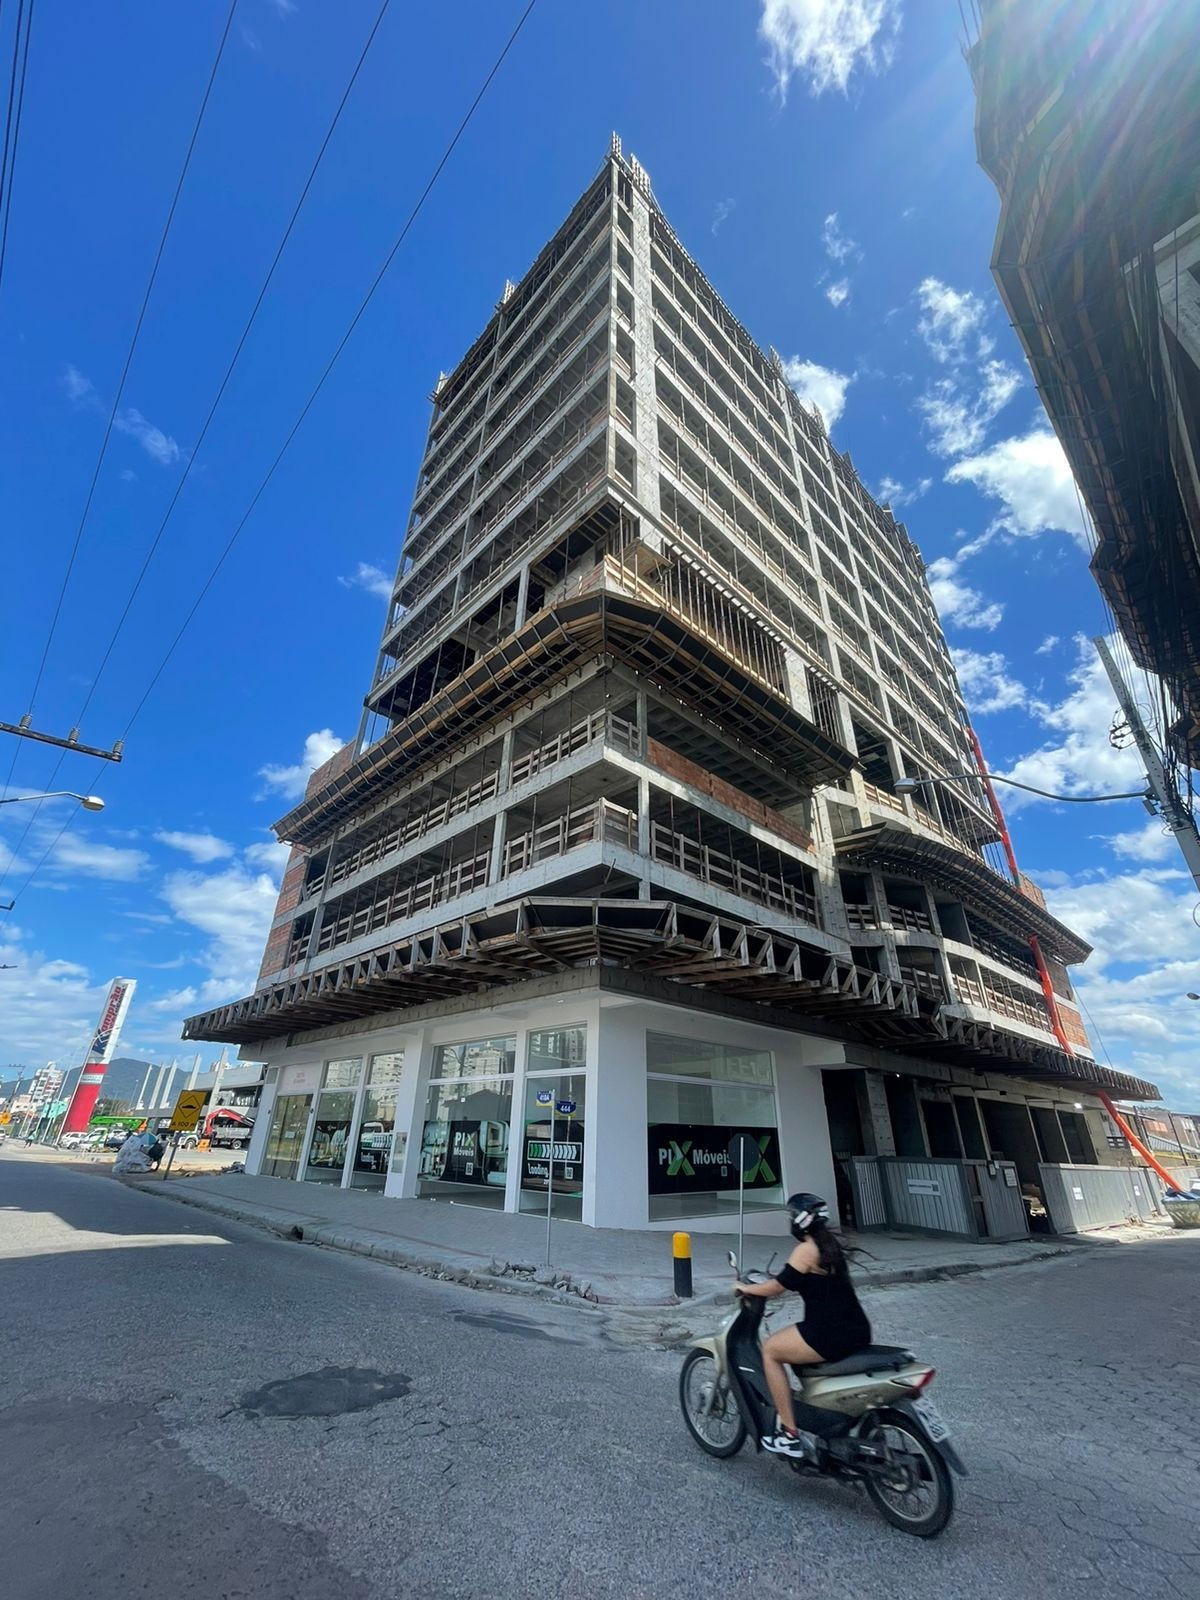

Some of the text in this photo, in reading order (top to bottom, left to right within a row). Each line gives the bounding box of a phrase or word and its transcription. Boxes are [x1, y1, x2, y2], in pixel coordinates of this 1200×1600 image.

[455, 1131, 475, 1147] PIX
[453, 1147, 474, 1157] Móveis
[658, 1141, 696, 1176] PIX
